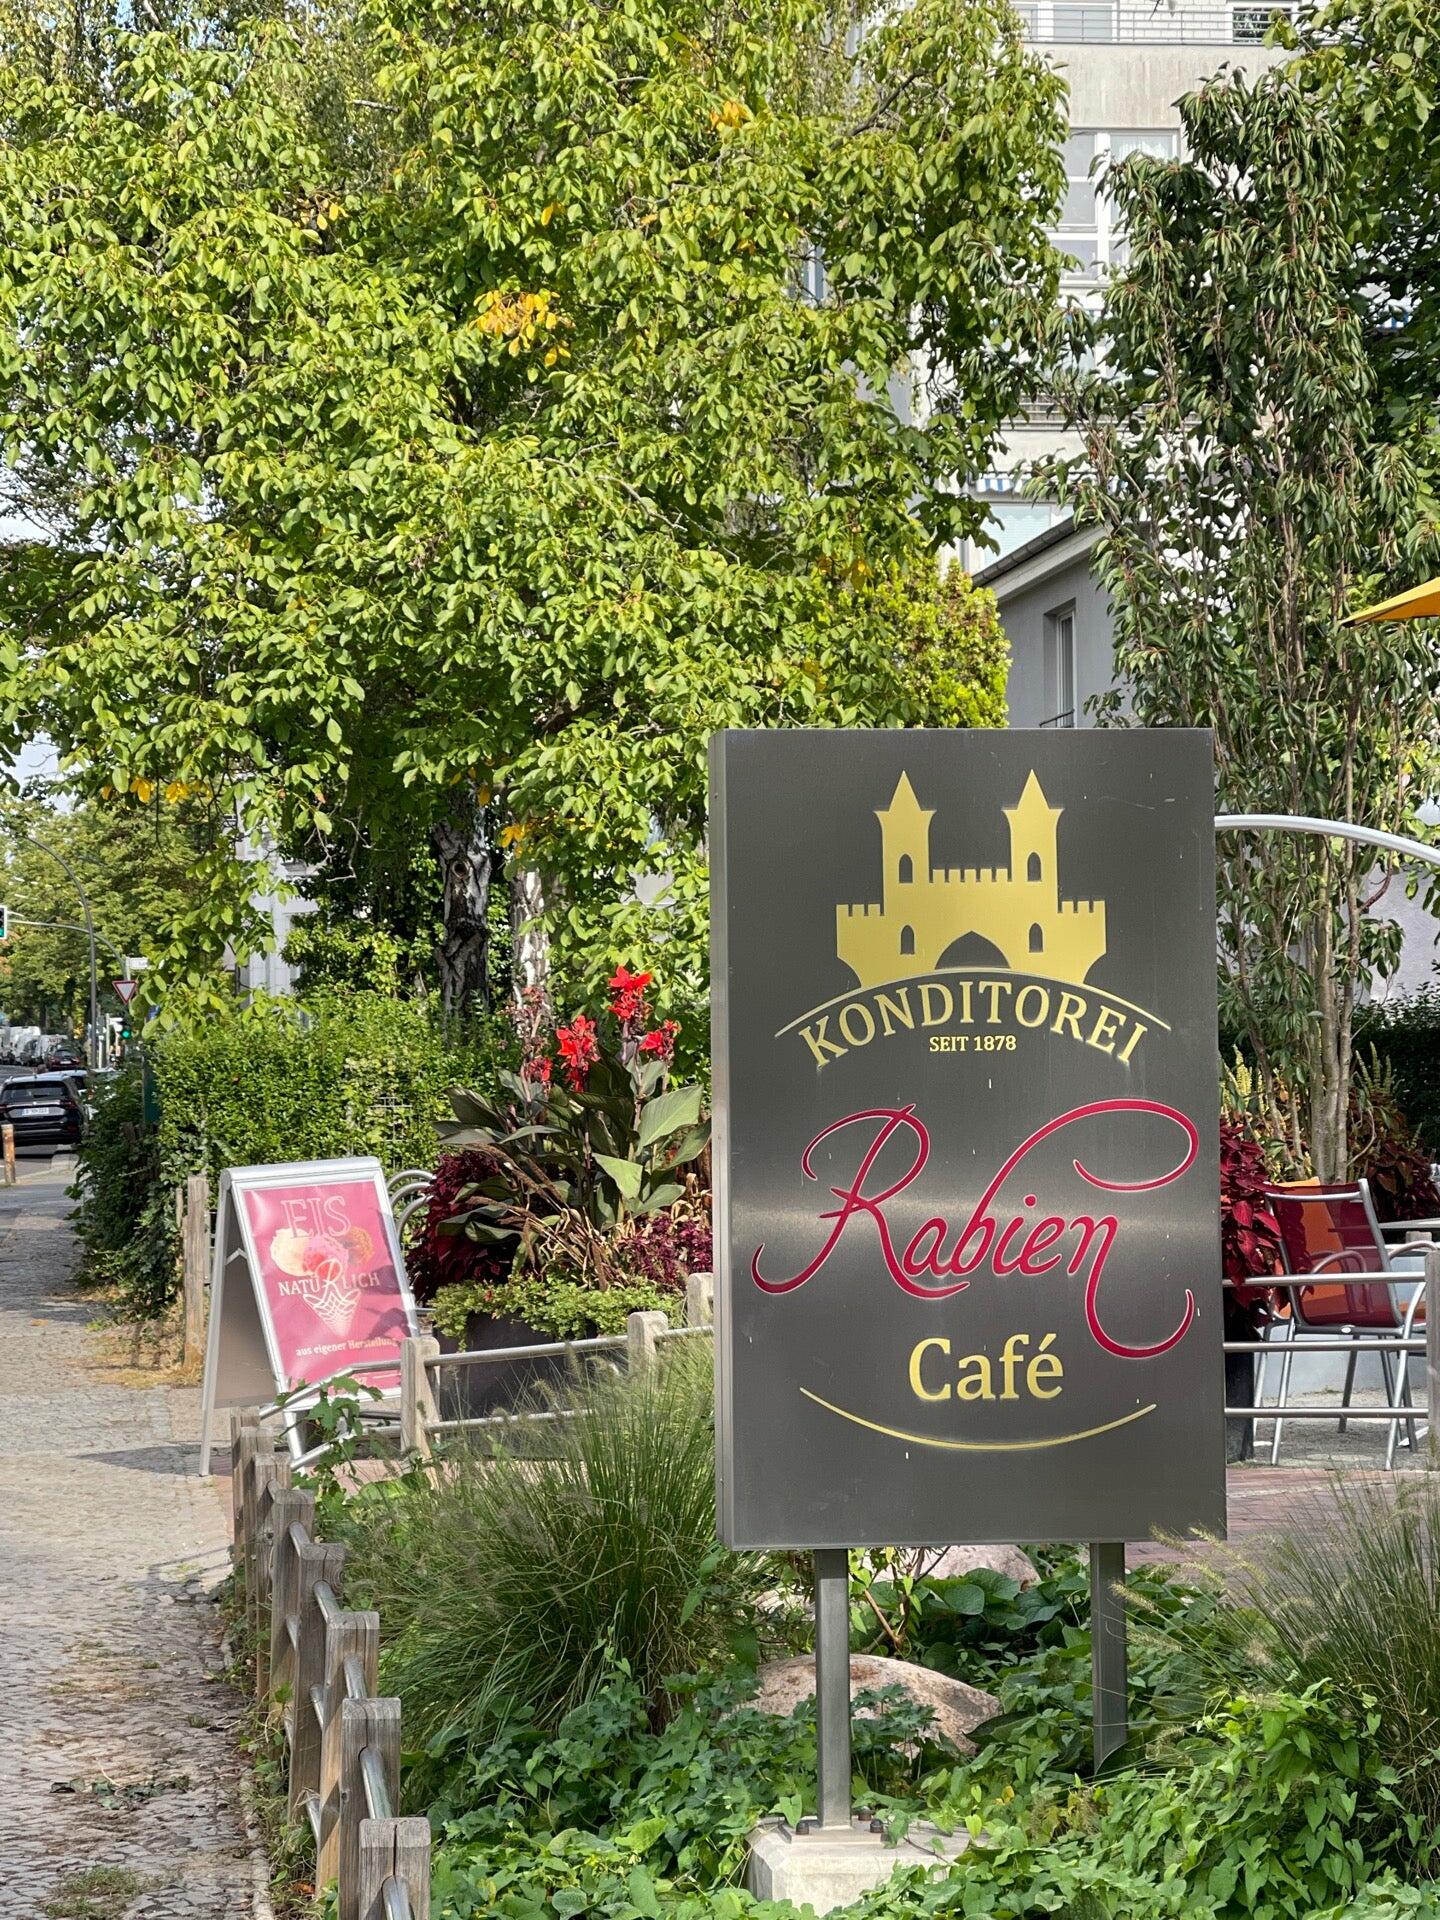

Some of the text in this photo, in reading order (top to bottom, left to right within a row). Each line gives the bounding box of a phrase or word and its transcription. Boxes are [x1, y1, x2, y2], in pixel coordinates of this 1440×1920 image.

[798, 980, 1149, 1067] KONDITOREI
[929, 1035, 1017, 1052] SEIT 1878
[280, 1195, 352, 1239] EIS
[751, 1098, 1199, 1359] Rabien
[278, 1258, 380, 1297] NATÜRLICH
[296, 1346, 313, 1356] aus
[314, 1342, 347, 1355] eigener
[909, 1333, 1064, 1401] Café
